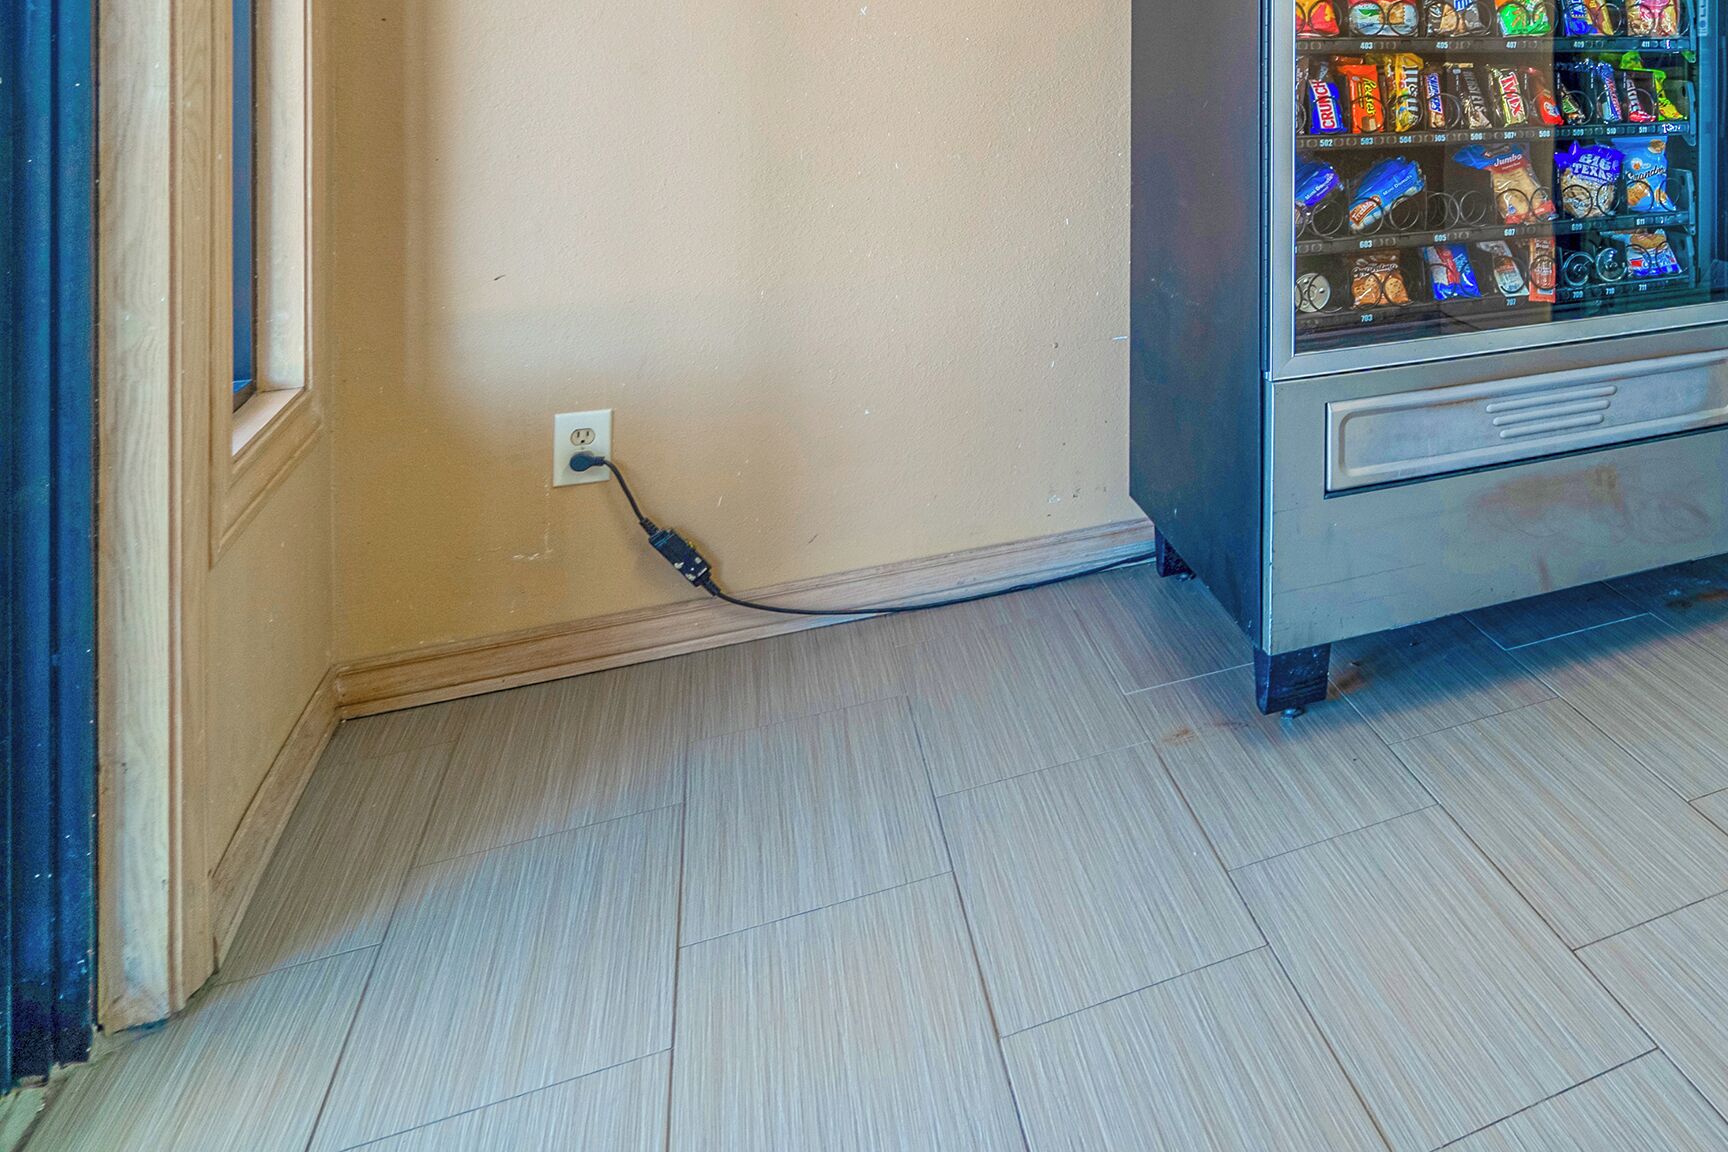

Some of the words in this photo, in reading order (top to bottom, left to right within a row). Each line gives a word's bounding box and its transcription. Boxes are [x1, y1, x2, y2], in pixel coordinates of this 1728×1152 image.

[1315, 79, 1336, 129] CRUNCH
[1494, 153, 1523, 168] Jumbo
[1579, 154, 1611, 171] BIG
[1572, 162, 1613, 182] TEXAS
